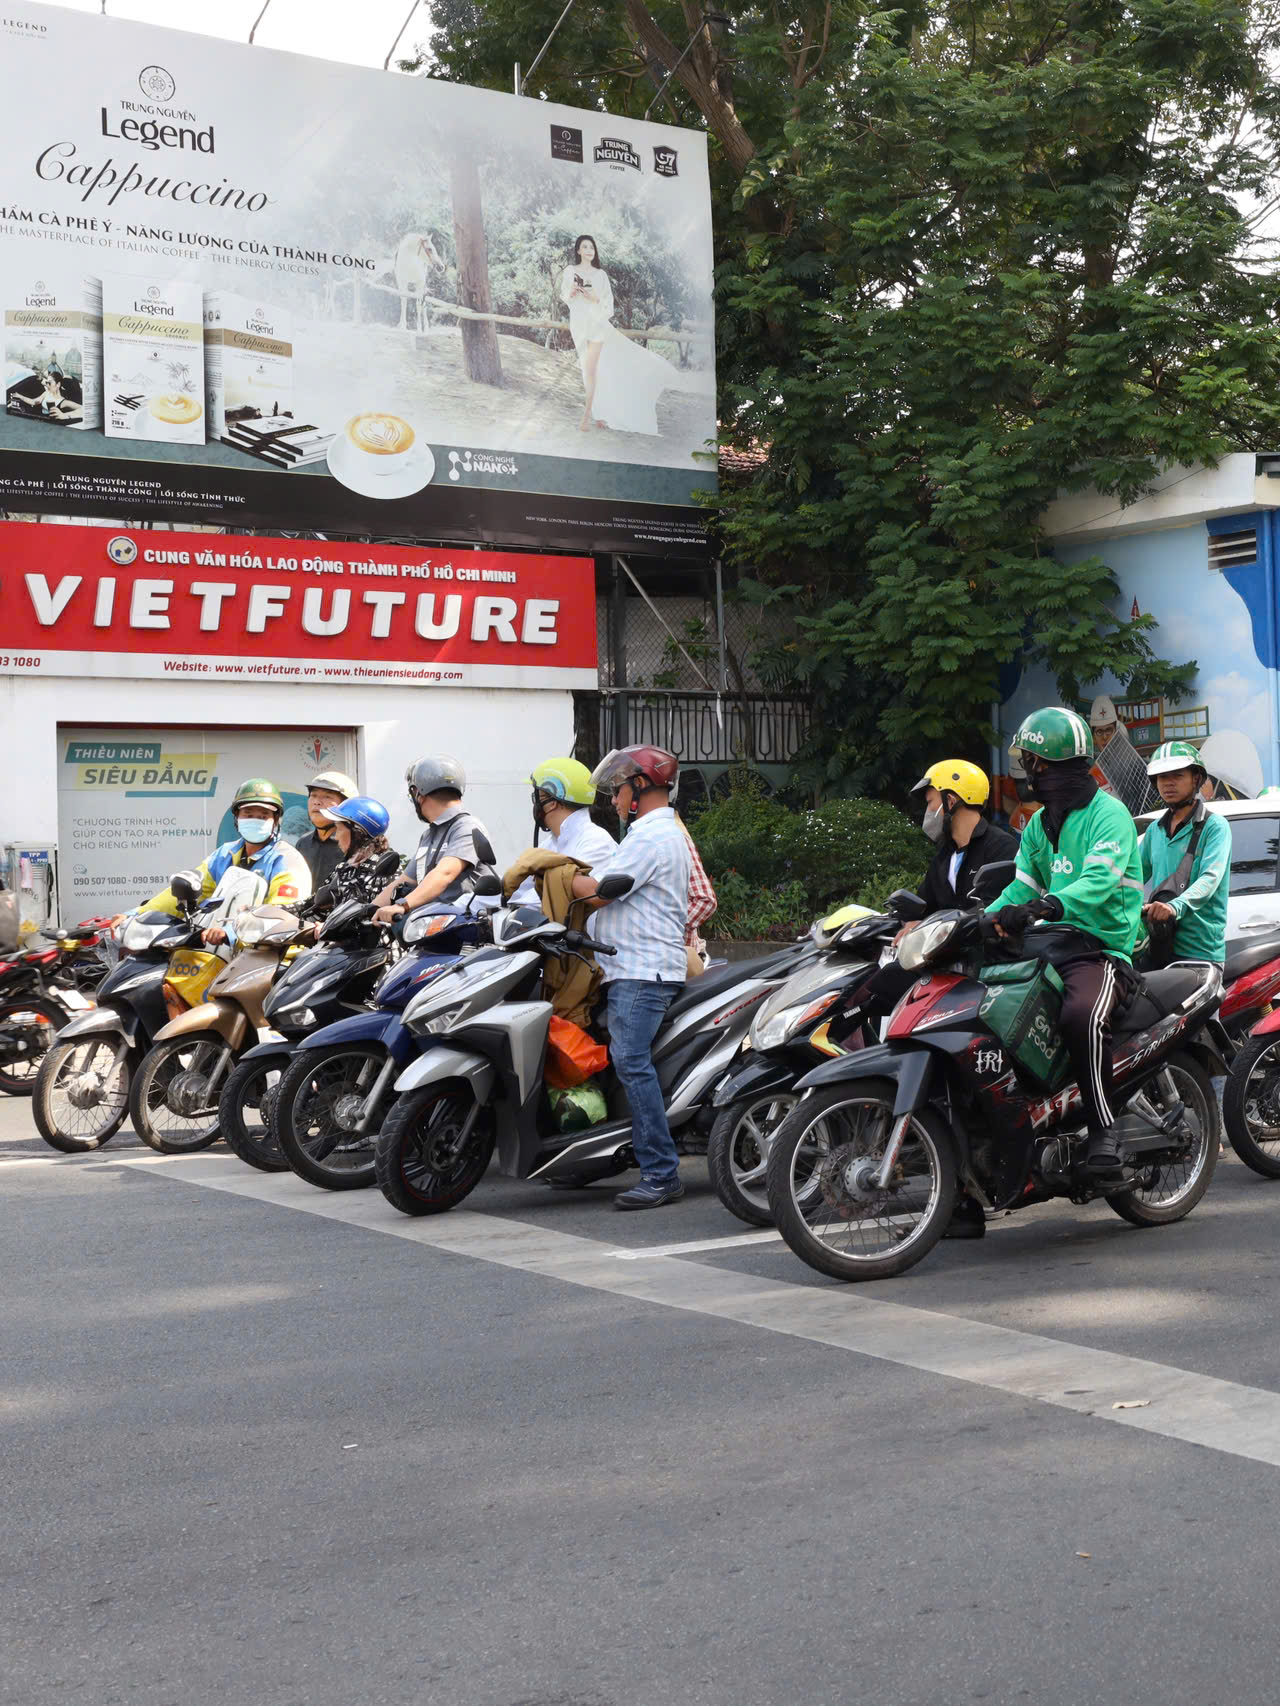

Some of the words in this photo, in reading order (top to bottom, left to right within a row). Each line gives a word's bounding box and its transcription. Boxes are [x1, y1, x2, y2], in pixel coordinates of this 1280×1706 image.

[3, 19, 48, 33] LEGEND
[120, 100, 155, 115] TRUNG
[156, 106, 196, 122] NGUYÊN
[101, 107, 215, 154] Legend
[603, 140, 629, 151] TRUNG
[35, 141, 272, 212] Cappuccino
[38, 211, 61, 226] CÀ
[66, 215, 98, 231] PHÊ
[102, 219, 113, 233] Ý
[126, 224, 173, 242] NĂNG
[238, 239, 270, 256] CỦA
[273, 245, 328, 264] THÀNH
[332, 253, 376, 271] CÔNG
[99, 238, 113, 248] OF
[117, 240, 159, 254] ITALIAN
[211, 253, 232, 265] THE
[235, 257, 275, 271] ENERGY
[278, 262, 320, 276] SUCCESS
[25, 296, 56, 308] Legend
[134, 301, 174, 316] Legend
[13, 310, 68, 327] Cappuccino
[118, 315, 189, 335] Cappuccino
[245, 319, 274, 336] Legend
[233, 331, 284, 351] Cappuccino
[473, 454, 494, 462] CÔNG
[13, 478, 25, 487] CÀ
[28, 480, 44, 488] PHÊ
[96, 485, 125, 494] THÀNH
[127, 487, 152, 496] CÔNG
[60, 474, 90, 483] TRUNG
[92, 477, 127, 486] NGUYÊN
[129, 480, 161, 489] LEGEND
[143, 549, 190, 565] CUNG
[195, 549, 227, 567] VĂN
[230, 551, 264, 570] HÓA
[267, 557, 298, 571] LAO
[301, 556, 344, 576] ĐỘNG
[348, 559, 398, 577] THÀNH
[401, 560, 430, 579] PHỐ
[434, 561, 454, 580] HỒ
[456, 567, 480, 582] CHI
[482, 569, 517, 584] MINH
[24, 572, 560, 645] VIETFUTURE
[13, 656, 41, 668] 1080
[163, 660, 213, 673] Website:
[215, 664, 316, 676] www.vietfuture.vn
[324, 667, 463, 682] www.thieuniensieudang.com
[1021, 729, 1045, 745] Grab
[119, 747, 155, 759] NIÊN
[84, 765, 137, 785] SIÊU
[142, 761, 208, 785] ĐẲNG
[147, 829, 160, 837] RA
[73, 842, 96, 850] CHO
[1093, 839, 1121, 854] Grab
[1050, 855, 1074, 875] ab
[73, 877, 88, 886] 090
[91, 877, 105, 886] 507
[107, 877, 127, 886] 1080
[133, 876, 148, 885] 090
[150, 876, 164, 885] 983
[74, 889, 153, 897] www.vietfuture.vn
